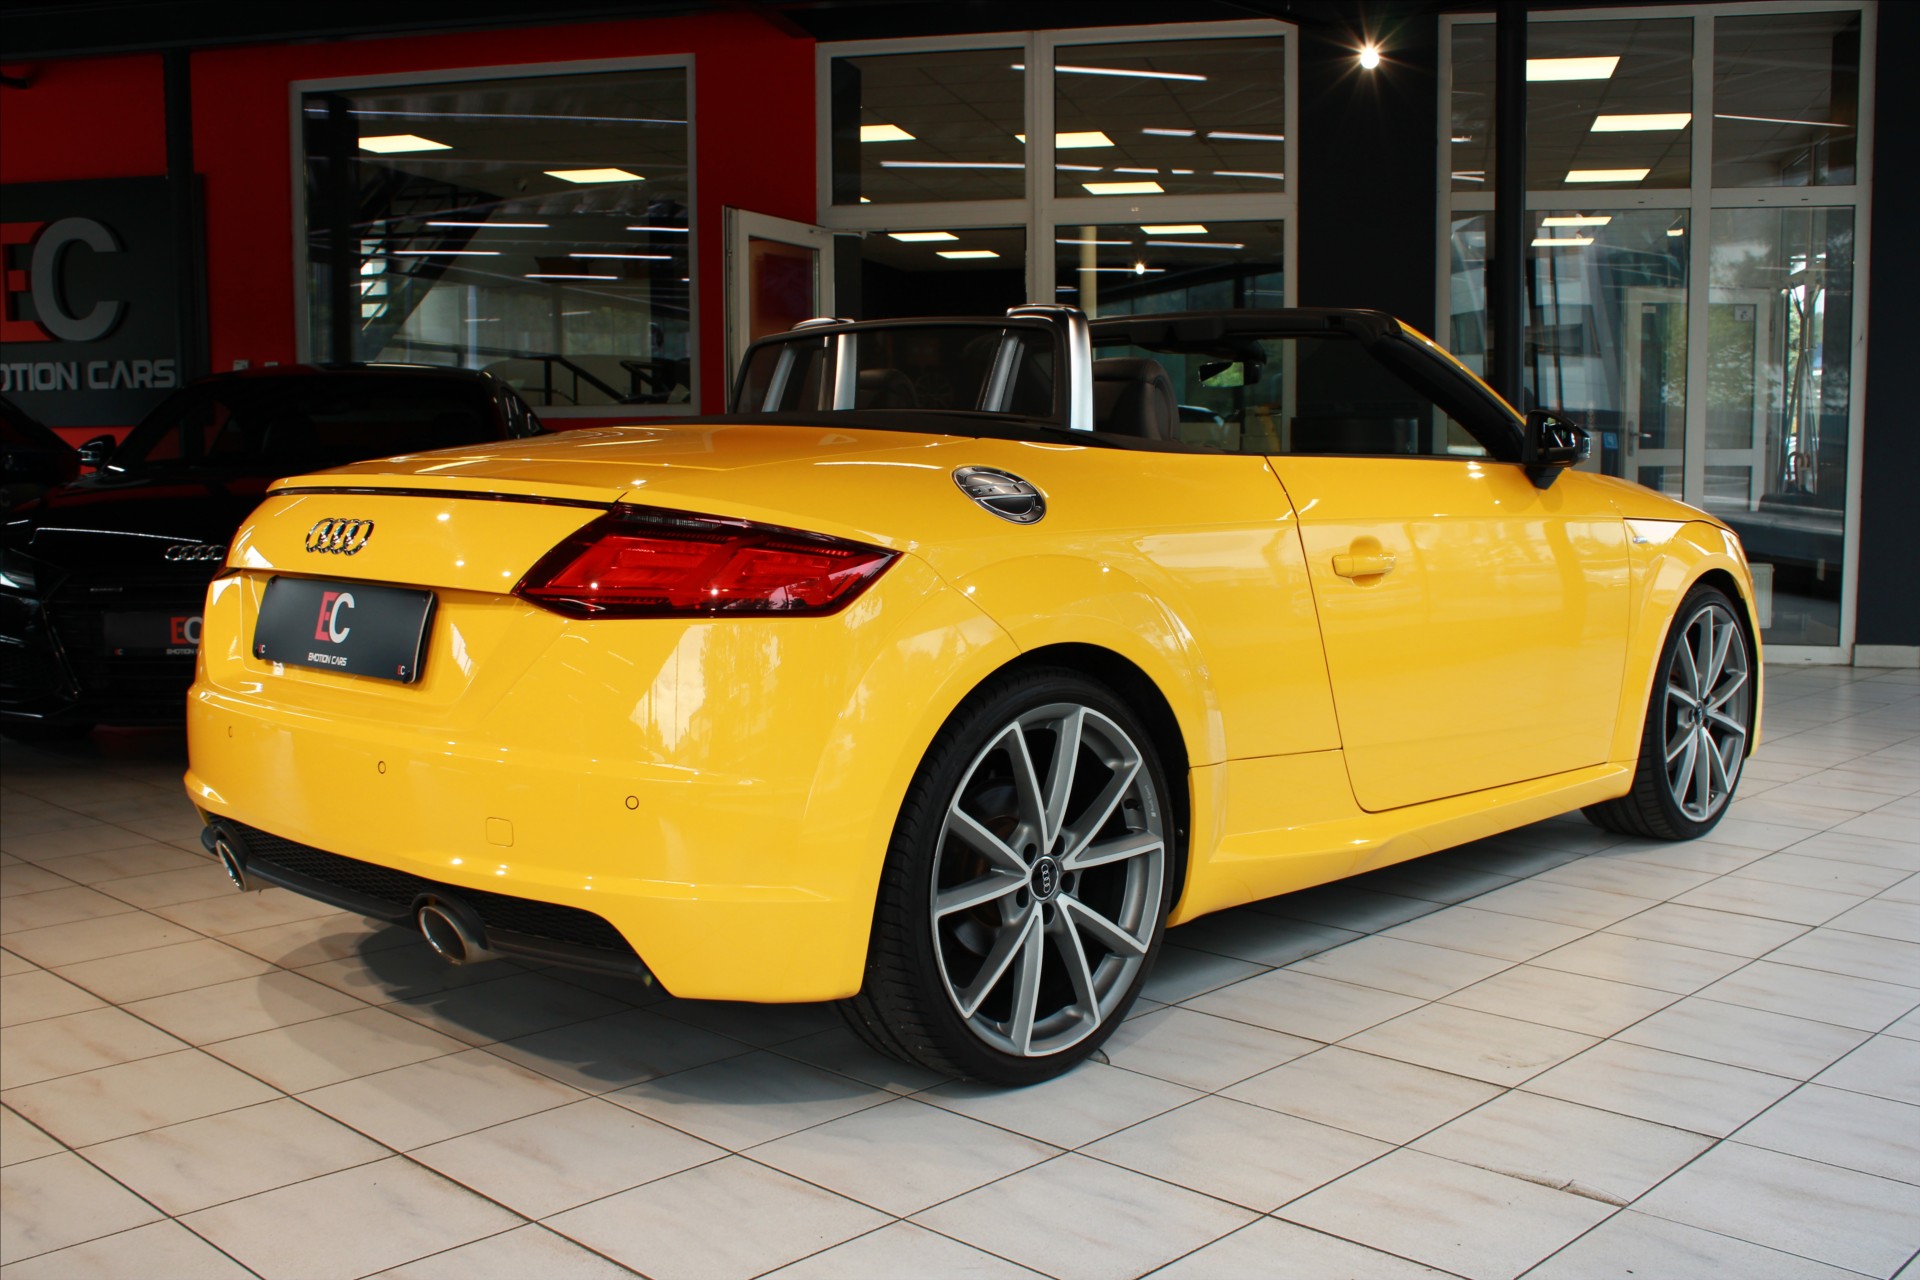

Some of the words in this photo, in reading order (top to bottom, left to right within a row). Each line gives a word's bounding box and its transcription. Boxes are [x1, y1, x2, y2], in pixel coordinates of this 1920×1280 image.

[0, 217, 119, 341] EC
[87, 359, 176, 390] CARS
[169, 616, 202, 645] EC
[314, 591, 355, 644] EC
[307, 652, 331, 664] EMOTION
[331, 655, 348, 667] CARS
[397, 665, 405, 675] EC
